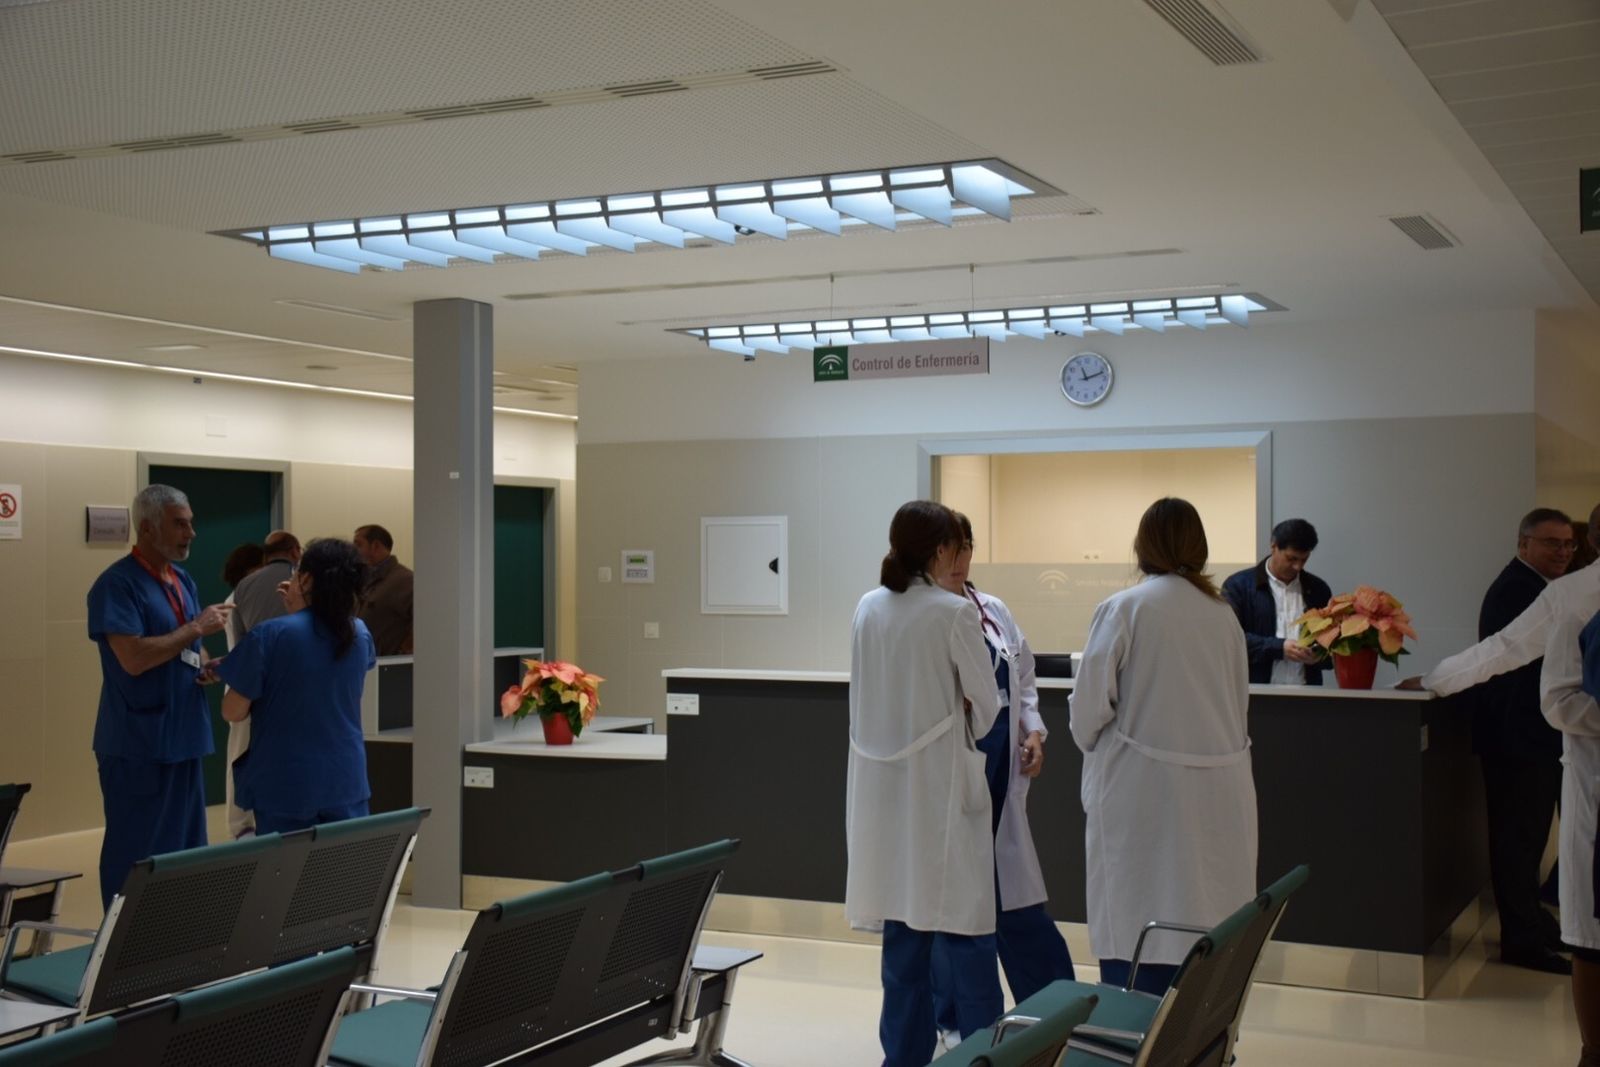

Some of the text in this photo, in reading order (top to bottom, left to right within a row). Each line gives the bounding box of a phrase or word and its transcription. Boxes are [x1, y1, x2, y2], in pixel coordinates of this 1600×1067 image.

[852, 352, 980, 372] Control de Enfermería
